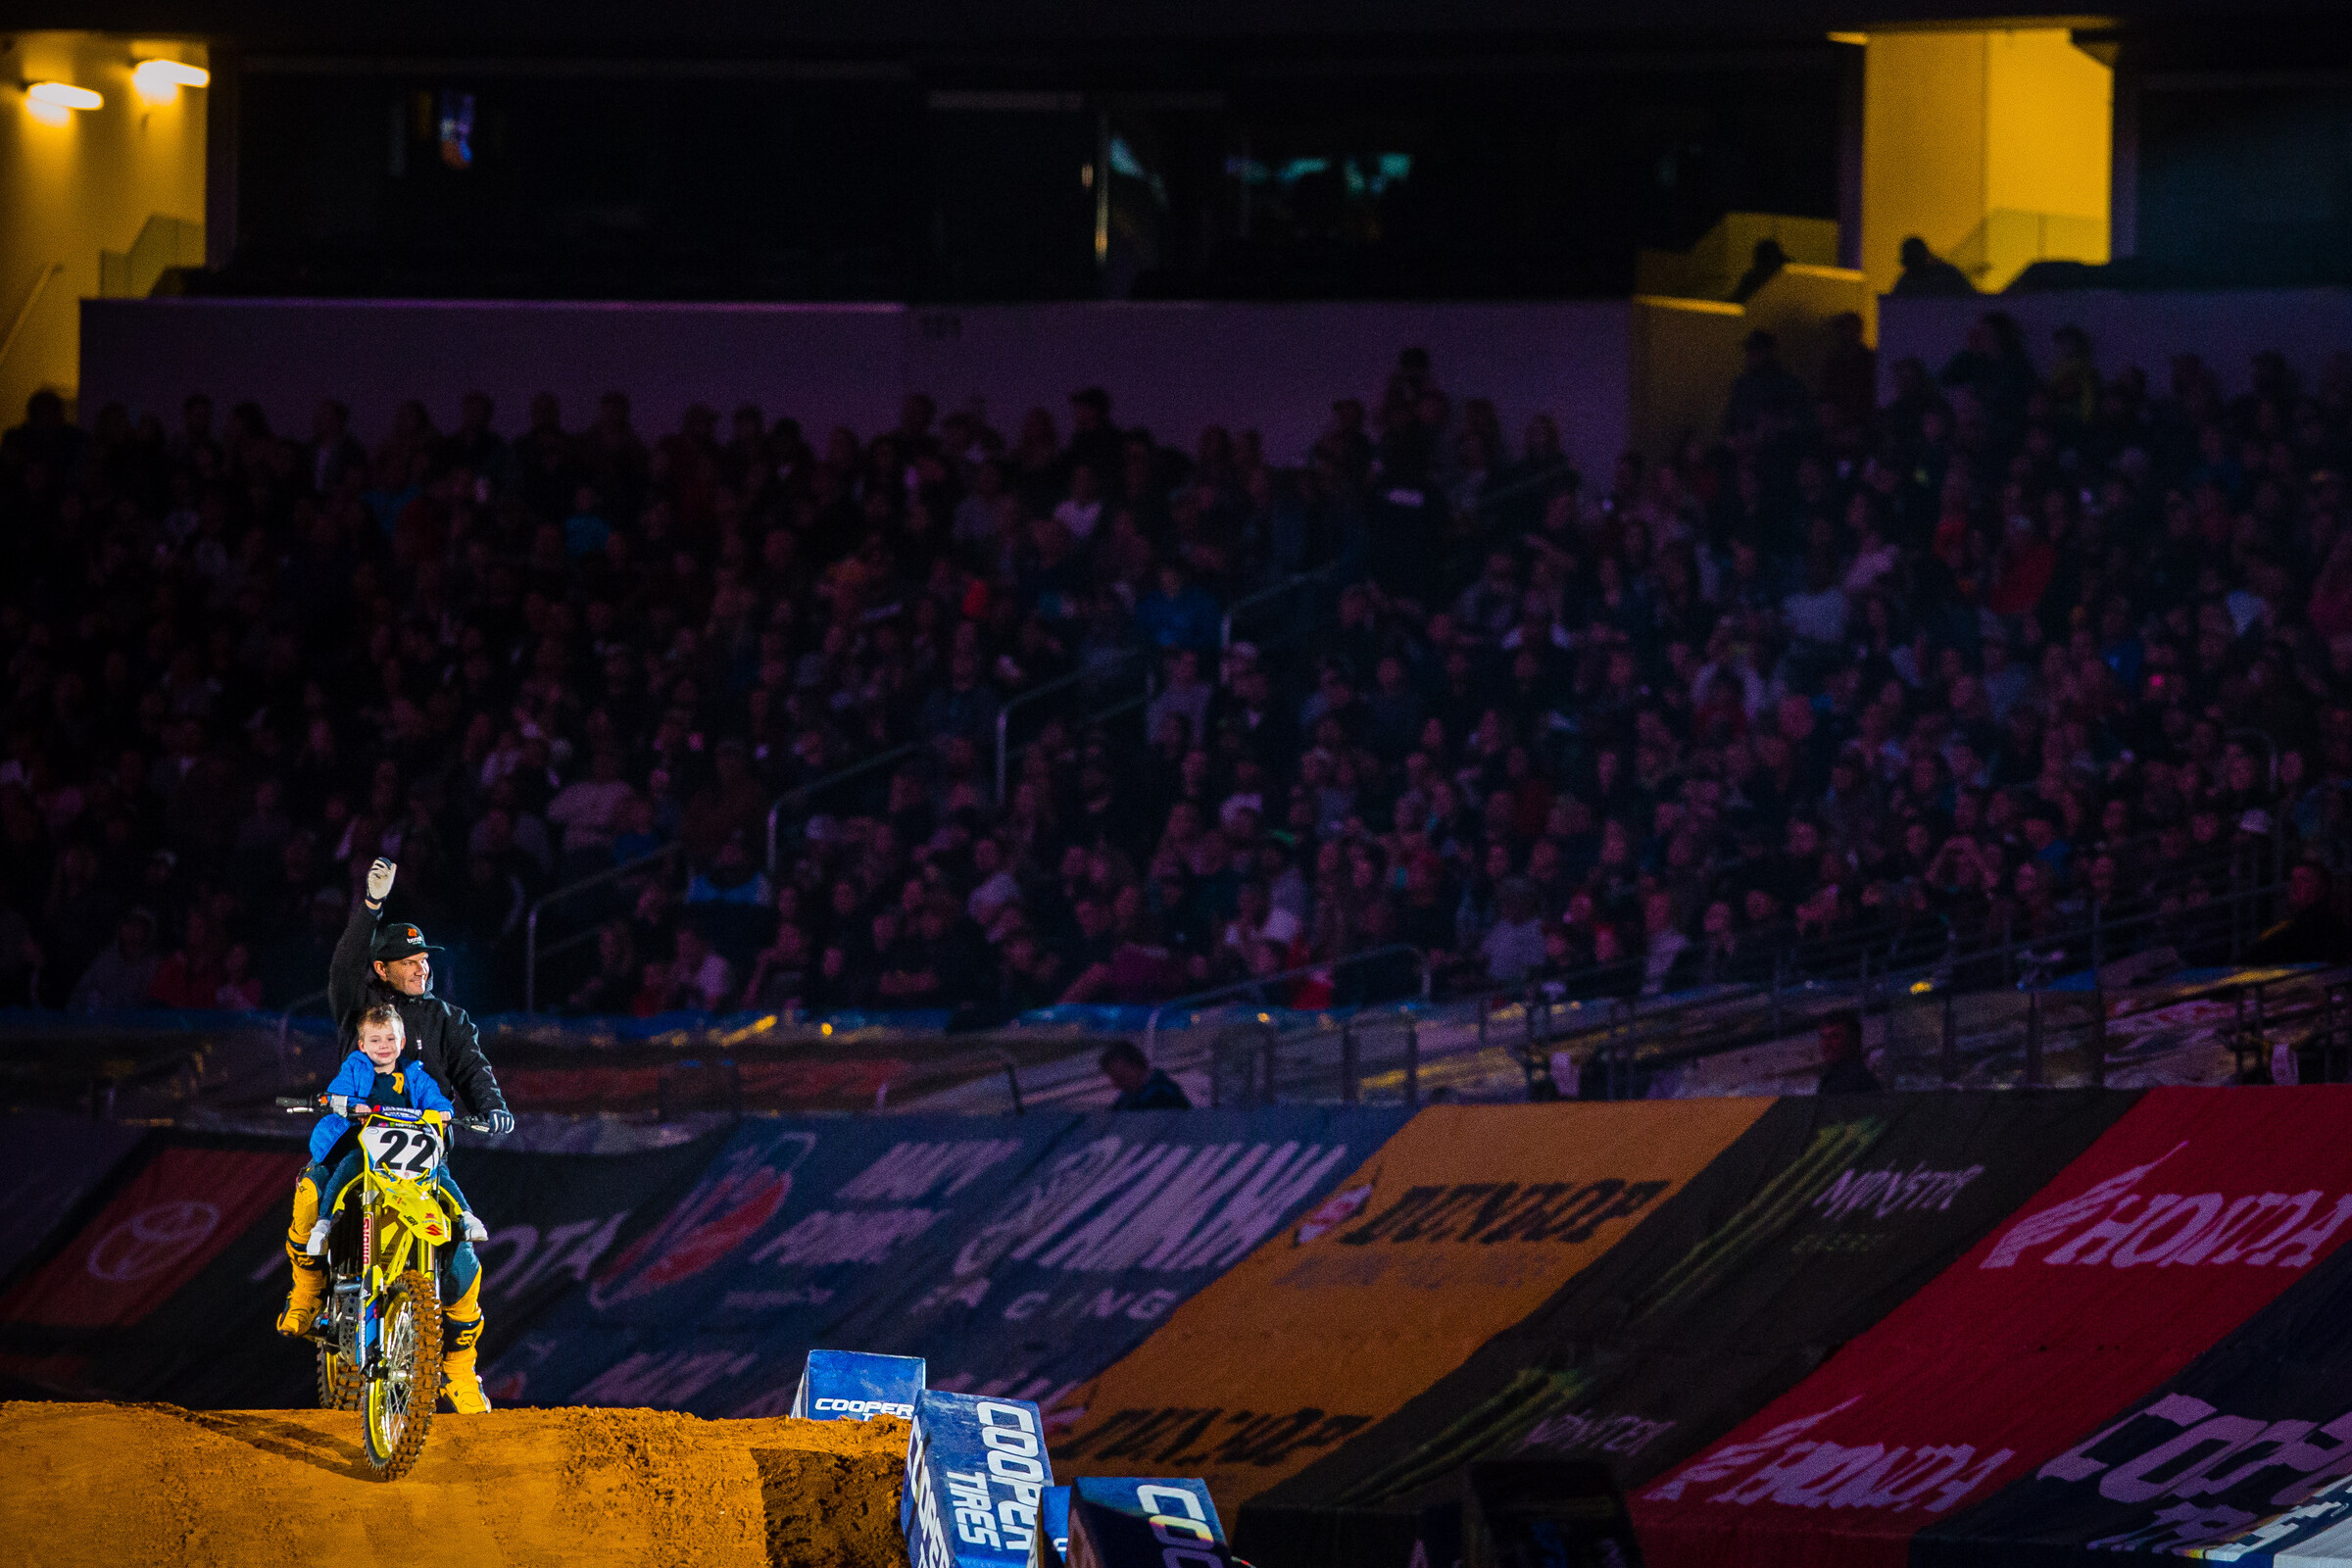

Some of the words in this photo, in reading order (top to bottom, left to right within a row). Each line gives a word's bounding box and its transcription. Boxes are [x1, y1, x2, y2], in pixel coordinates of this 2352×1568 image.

[374, 1130, 437, 1176] 22
[2042, 1189, 2352, 1268] HONDA
[814, 1397, 914, 1417] COOPER
[947, 1471, 1002, 1548] TIRES
[976, 1401, 1045, 1551] COOPER
